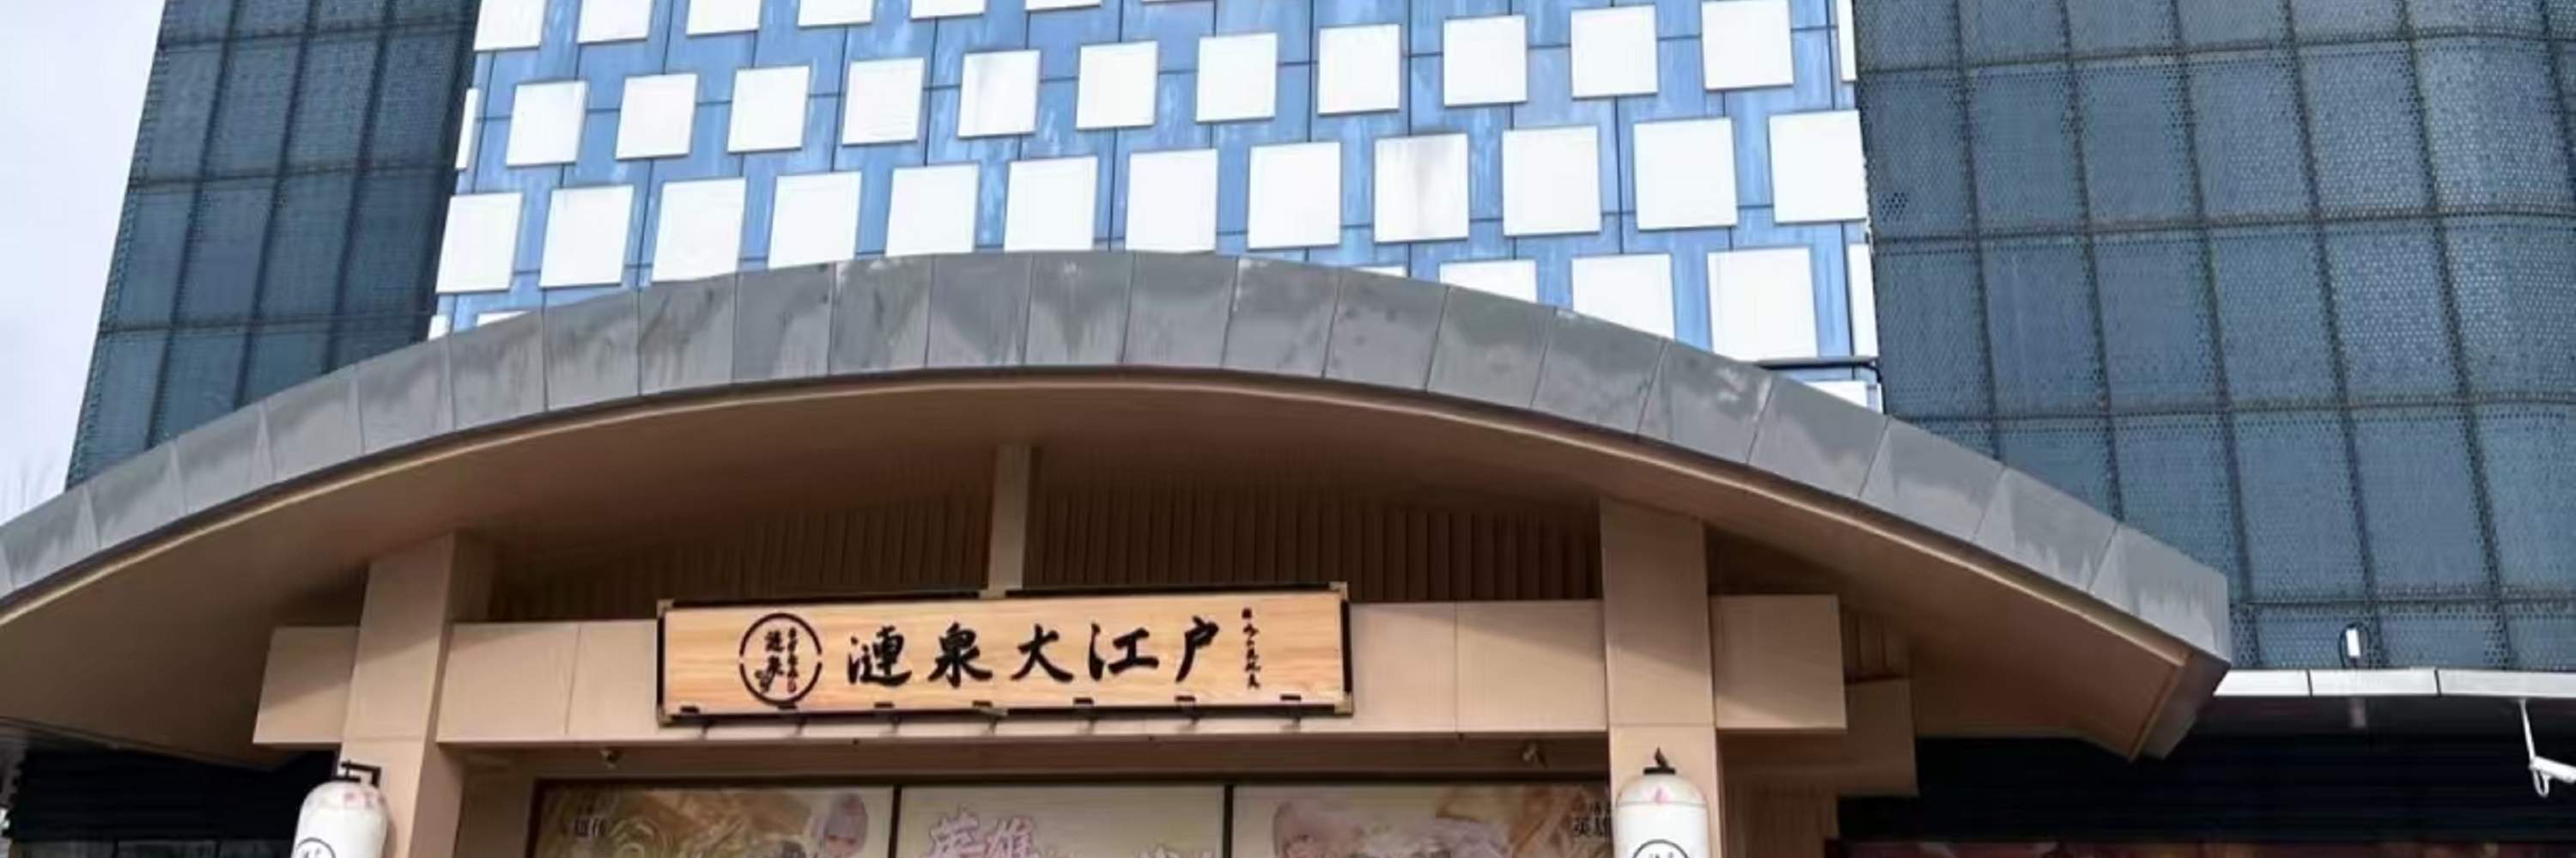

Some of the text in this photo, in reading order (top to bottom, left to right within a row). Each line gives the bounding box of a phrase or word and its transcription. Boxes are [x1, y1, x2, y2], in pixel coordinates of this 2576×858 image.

[848, 617, 1219, 689] 漣泉大江户
